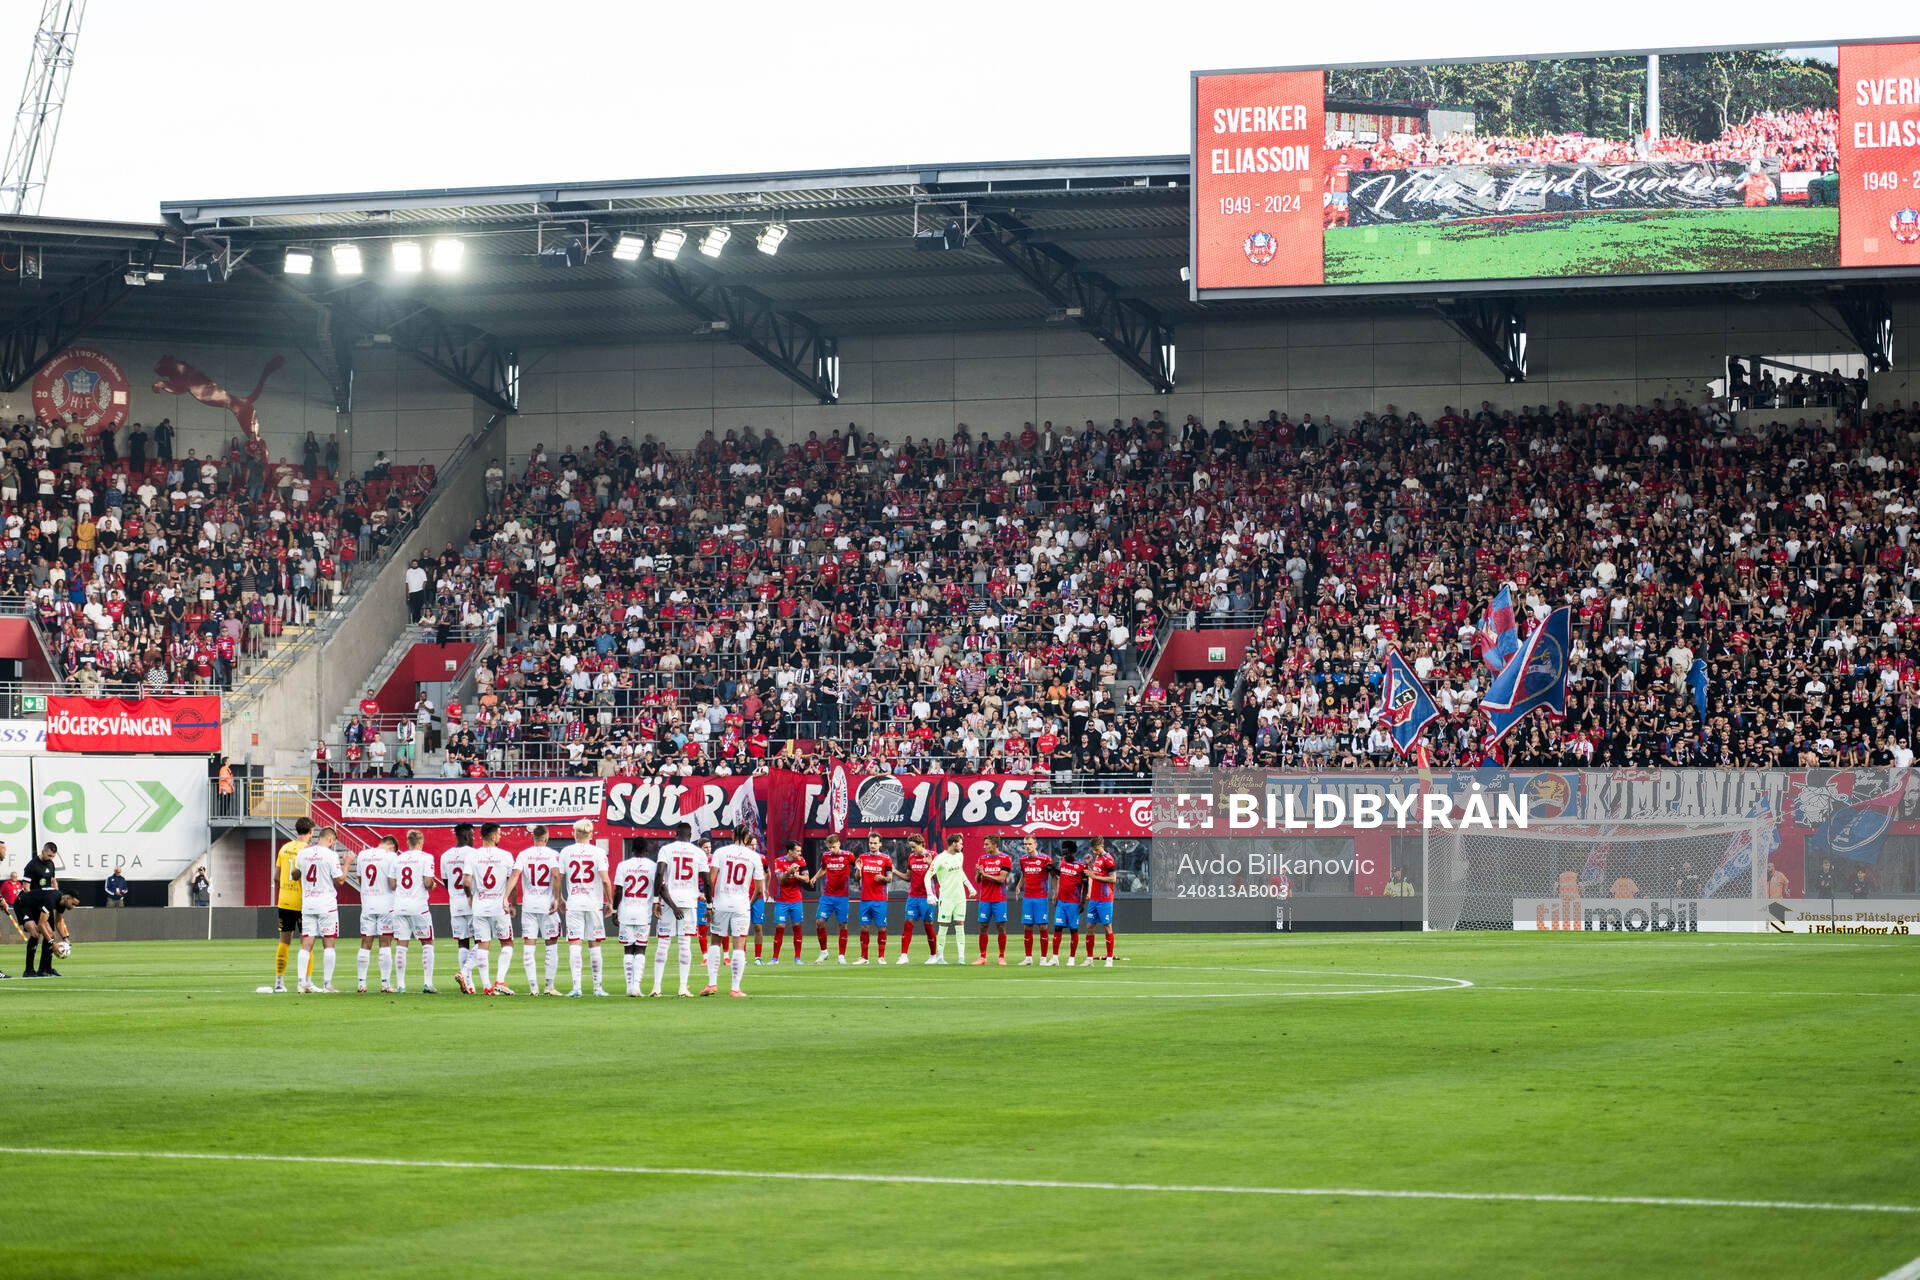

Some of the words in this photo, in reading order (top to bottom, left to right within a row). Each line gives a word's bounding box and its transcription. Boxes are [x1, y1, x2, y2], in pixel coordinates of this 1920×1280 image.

[1213, 105, 1307, 134] SVERKER
[1211, 145, 1310, 175] ELIASSON
[1862, 171, 1898, 190] 1949
[1219, 196, 1251, 215] 1949
[1265, 195, 1301, 213] 2024
[48, 711, 172, 737] HÖGERSVÄNGEN
[347, 785, 473, 808] AVSTÄNGDA
[73, 853, 143, 868] ELEDA
[568, 860, 595, 883] 23
[672, 857, 694, 880] 15
[306, 863, 317, 887] 4
[365, 864, 377, 887] 9
[401, 866, 413, 890] 8
[482, 866, 496, 890] 6
[528, 863, 550, 887] 12
[726, 860, 747, 885] 10
[624, 875, 649, 898] 22
[1796, 911, 1853, 922] Jönssons
[1855, 912, 1920, 925] Plåtslageri
[1890, 925, 1910, 935] AB
